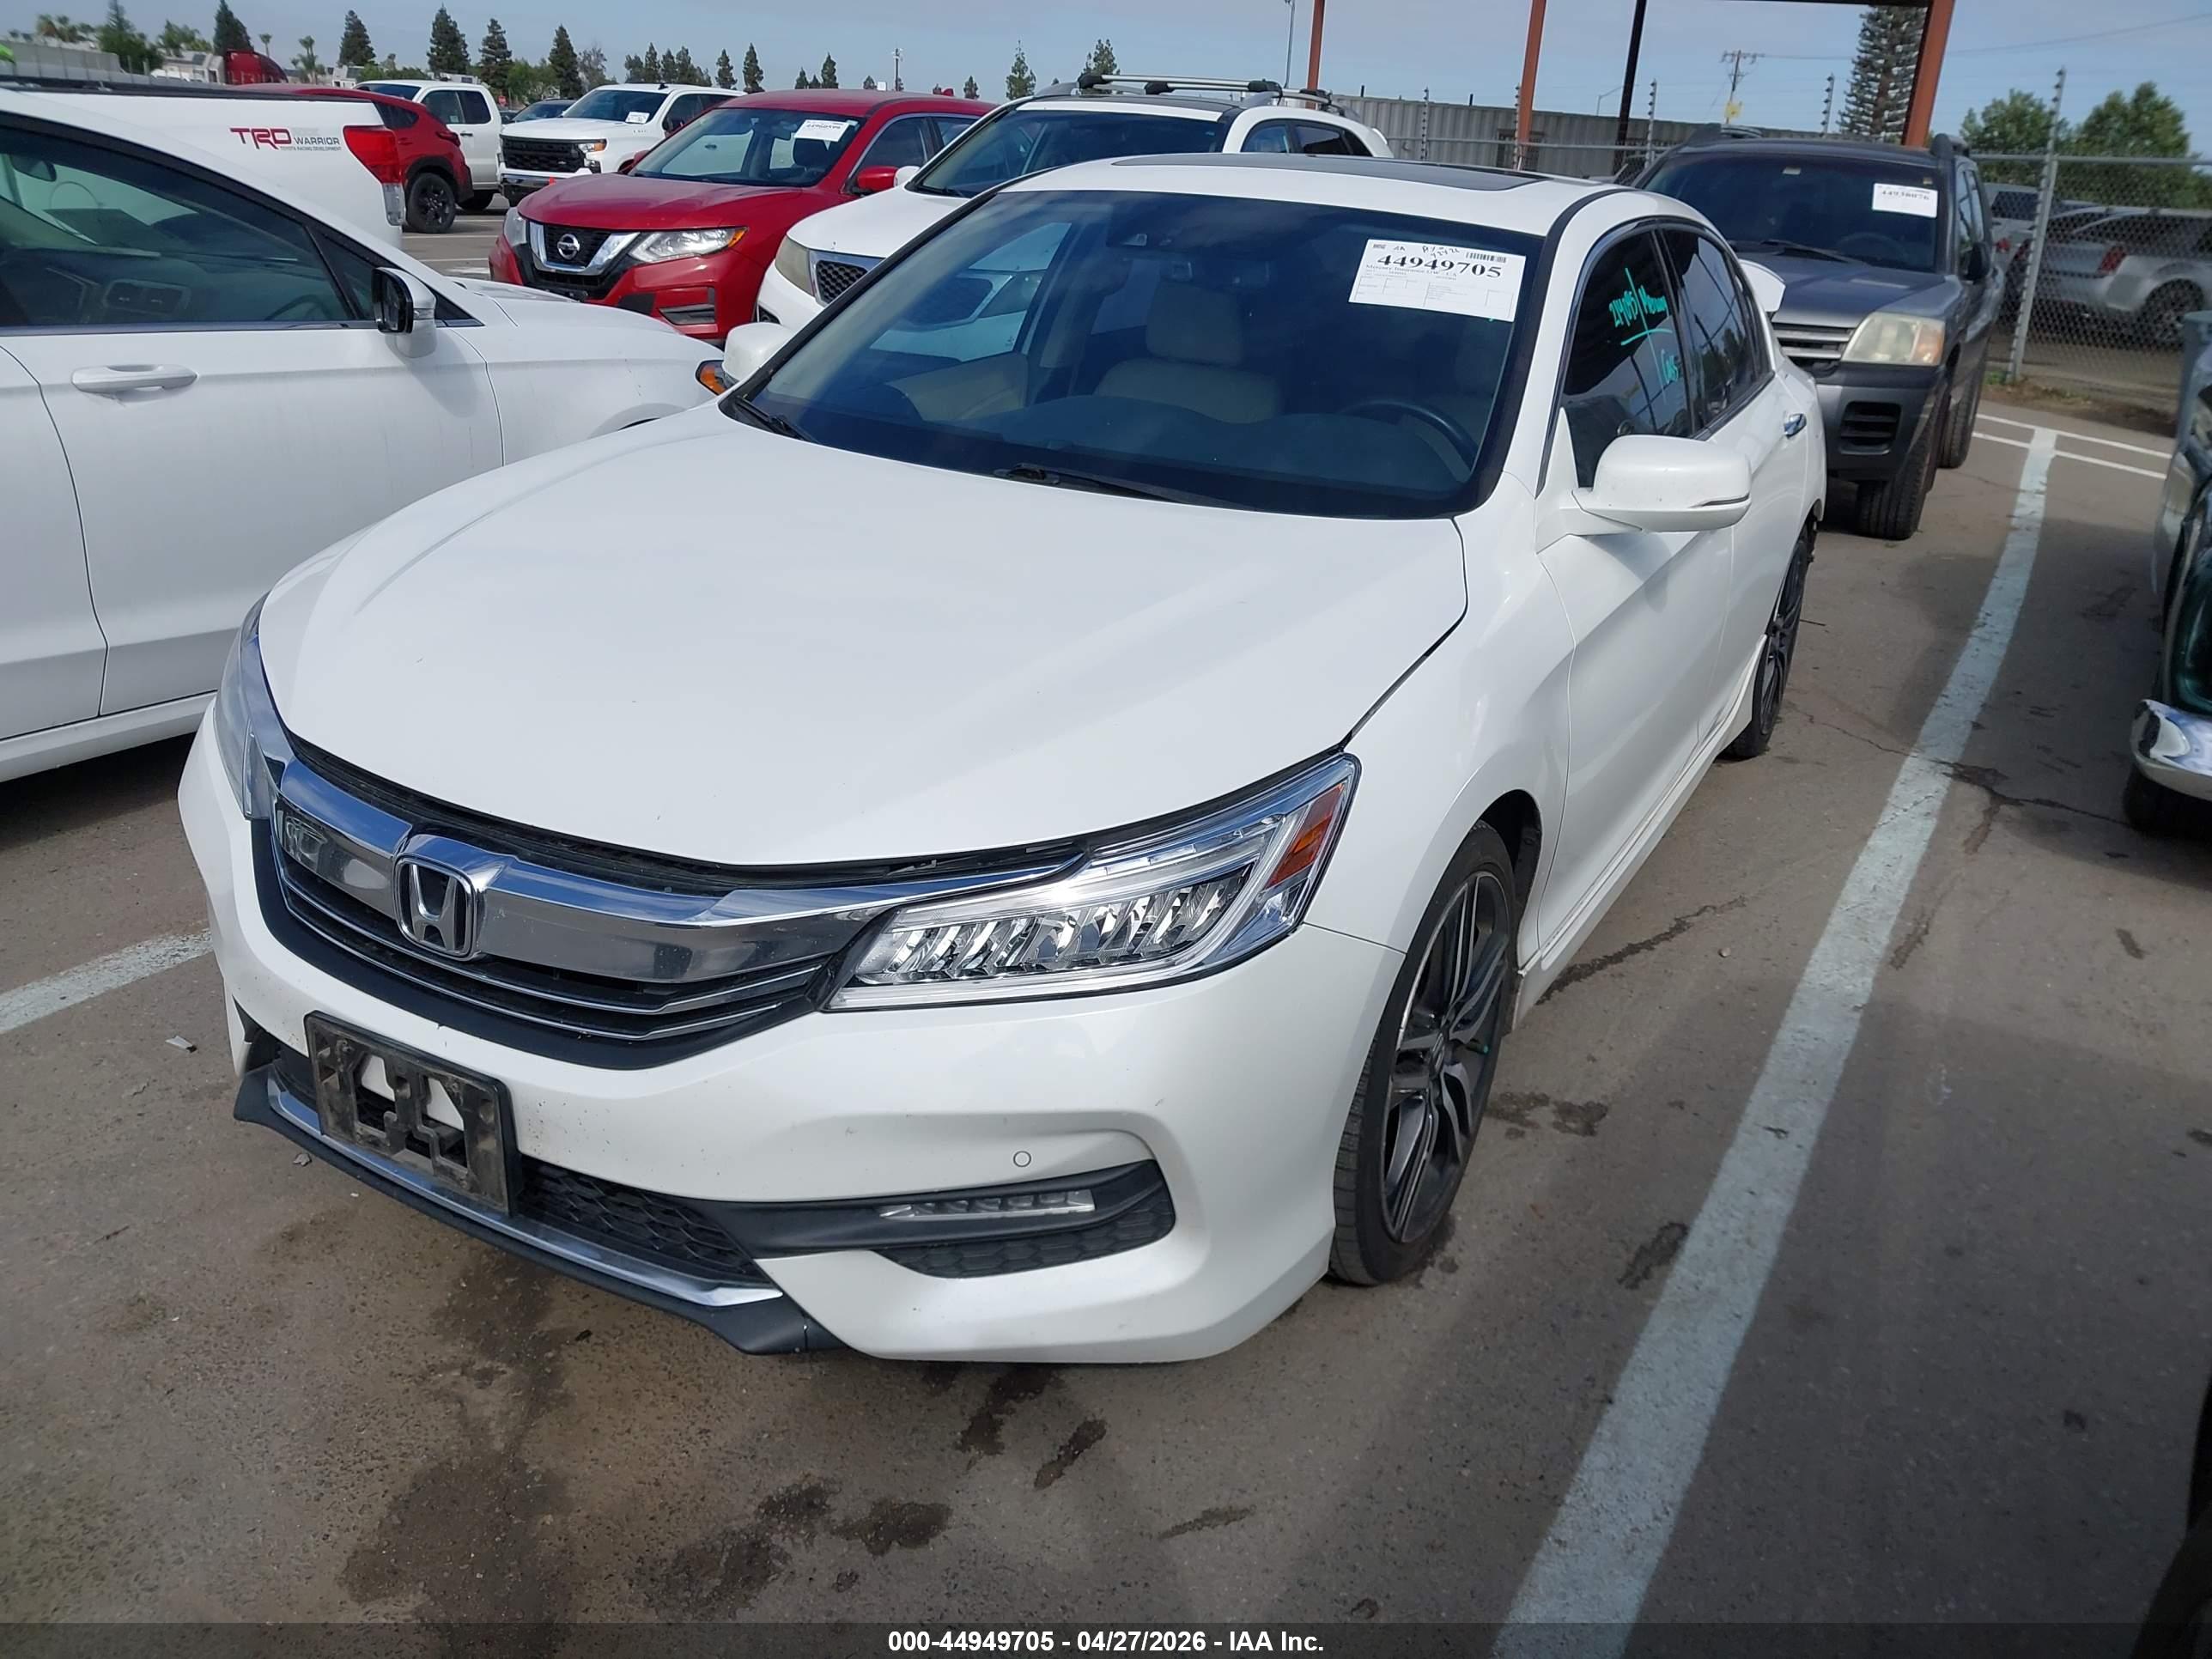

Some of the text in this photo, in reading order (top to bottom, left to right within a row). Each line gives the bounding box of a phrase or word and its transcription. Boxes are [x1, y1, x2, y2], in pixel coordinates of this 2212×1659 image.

[229, 128, 292, 149] TRD
[294, 137, 340, 145] WARRIOR
[1377, 254, 1503, 279] 44949705
